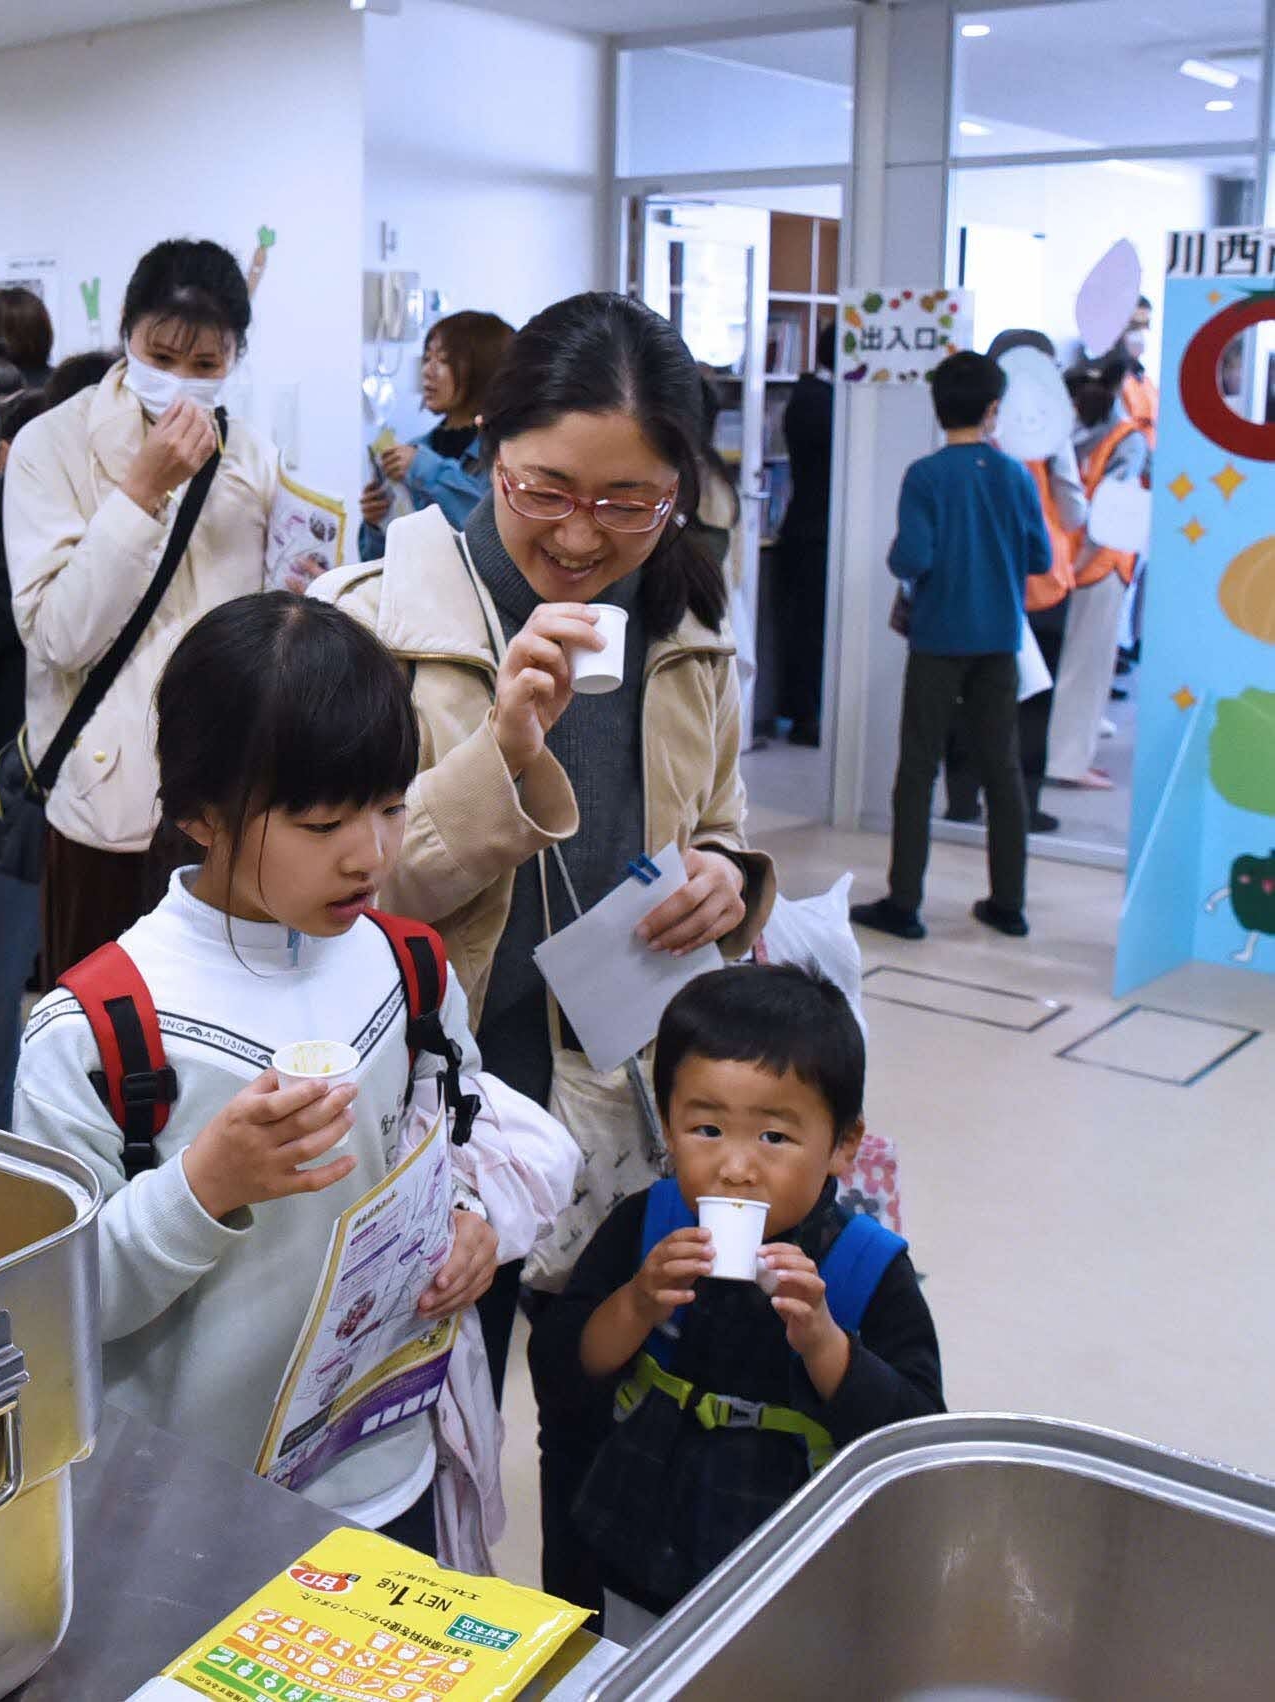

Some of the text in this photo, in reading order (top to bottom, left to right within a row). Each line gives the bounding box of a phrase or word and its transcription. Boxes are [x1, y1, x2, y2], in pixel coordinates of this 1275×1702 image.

[860, 324, 936, 351] 出入口
[203, 1030, 259, 1059] AMUSING
[297, 1572, 340, 1592] 甘口
[412, 1591, 454, 1613] NET
